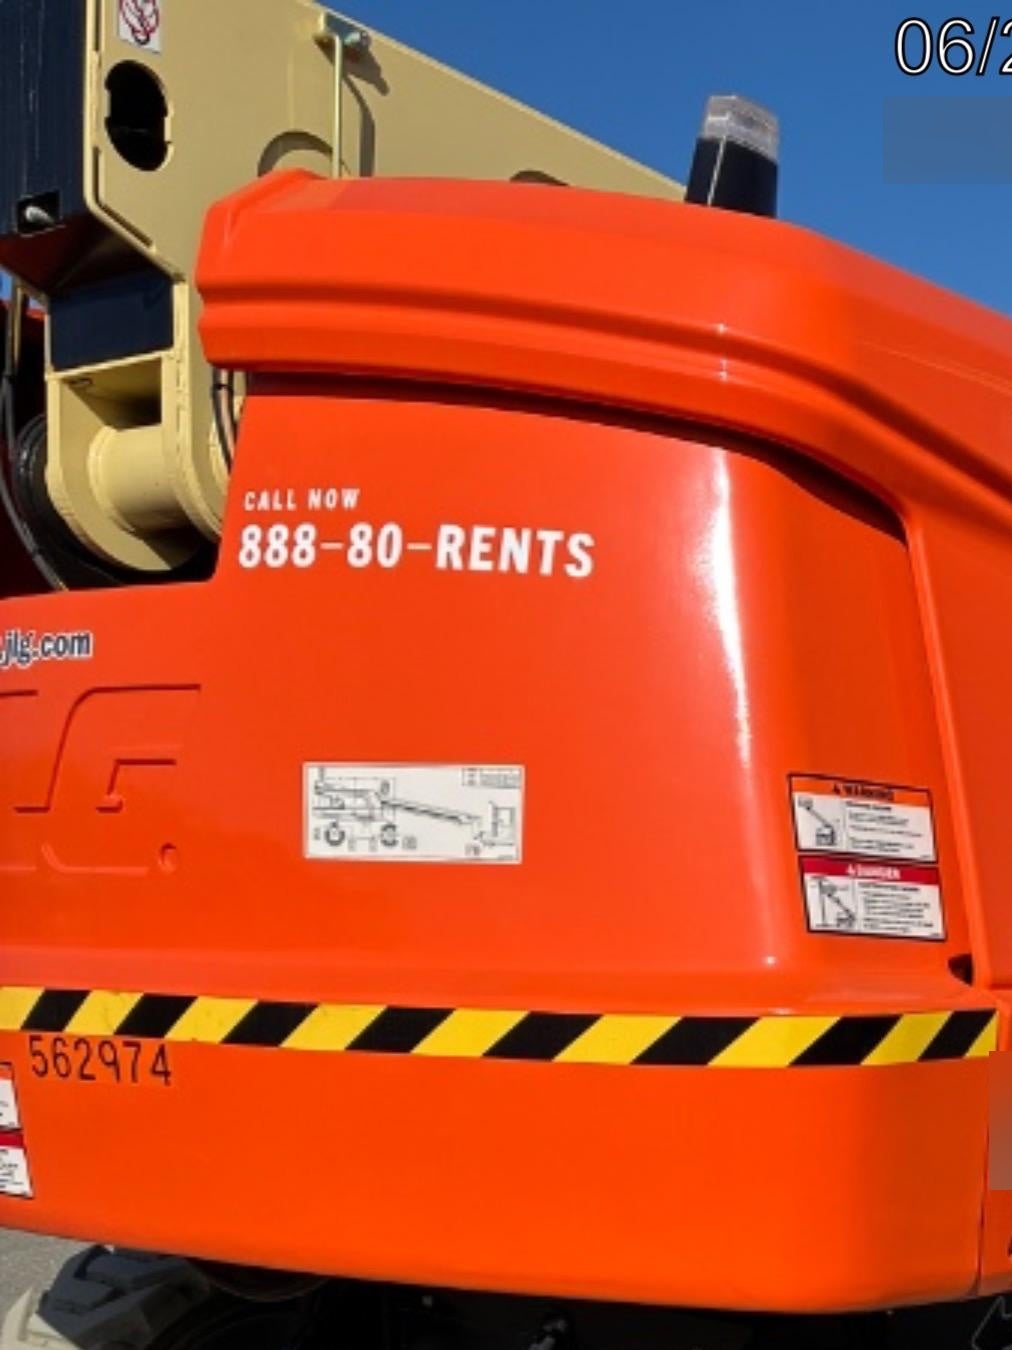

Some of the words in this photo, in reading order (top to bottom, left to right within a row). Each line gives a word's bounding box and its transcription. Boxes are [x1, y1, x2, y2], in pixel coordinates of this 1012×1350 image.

[244, 490, 297, 511] CALL
[307, 488, 361, 511] NOW
[238, 522, 596, 578] 888-80-RENTS
[28, 1034, 172, 1087] 562974
